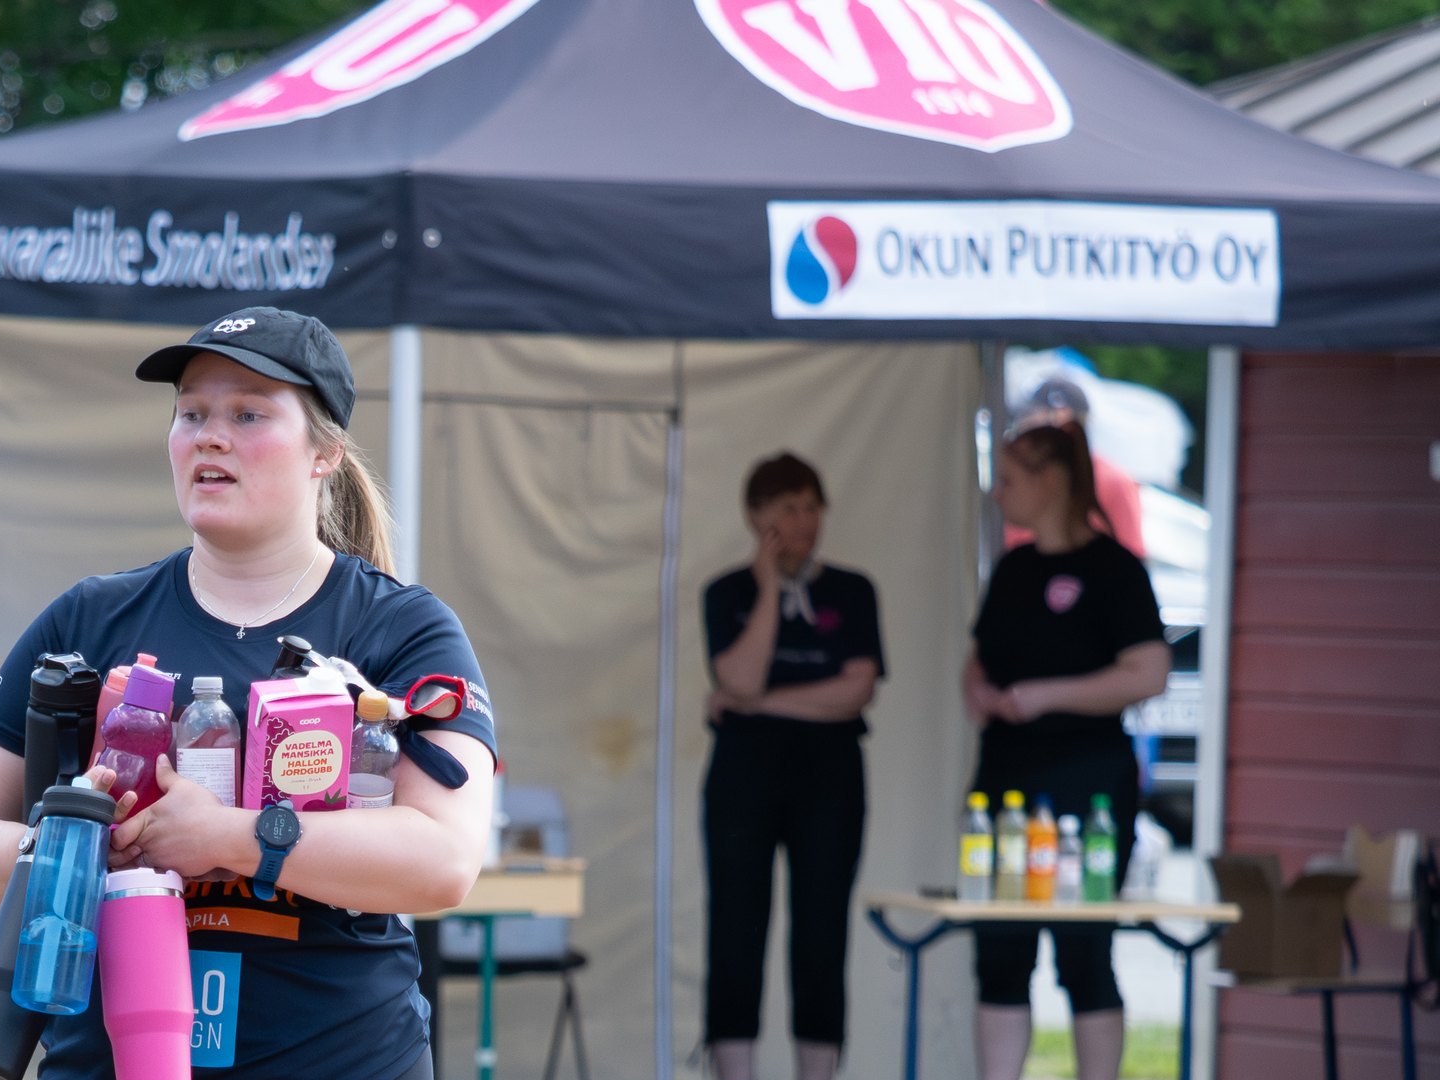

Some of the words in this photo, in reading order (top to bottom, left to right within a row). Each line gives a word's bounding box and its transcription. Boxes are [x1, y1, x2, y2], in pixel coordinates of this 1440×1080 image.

[141, 210, 337, 291] Smolander
[285, 740, 333, 751] VADELMA
[281, 748, 334, 759] MANSIKKA
[287, 758, 328, 768] HALLON
[280, 765, 333, 777] JORDGUBB
